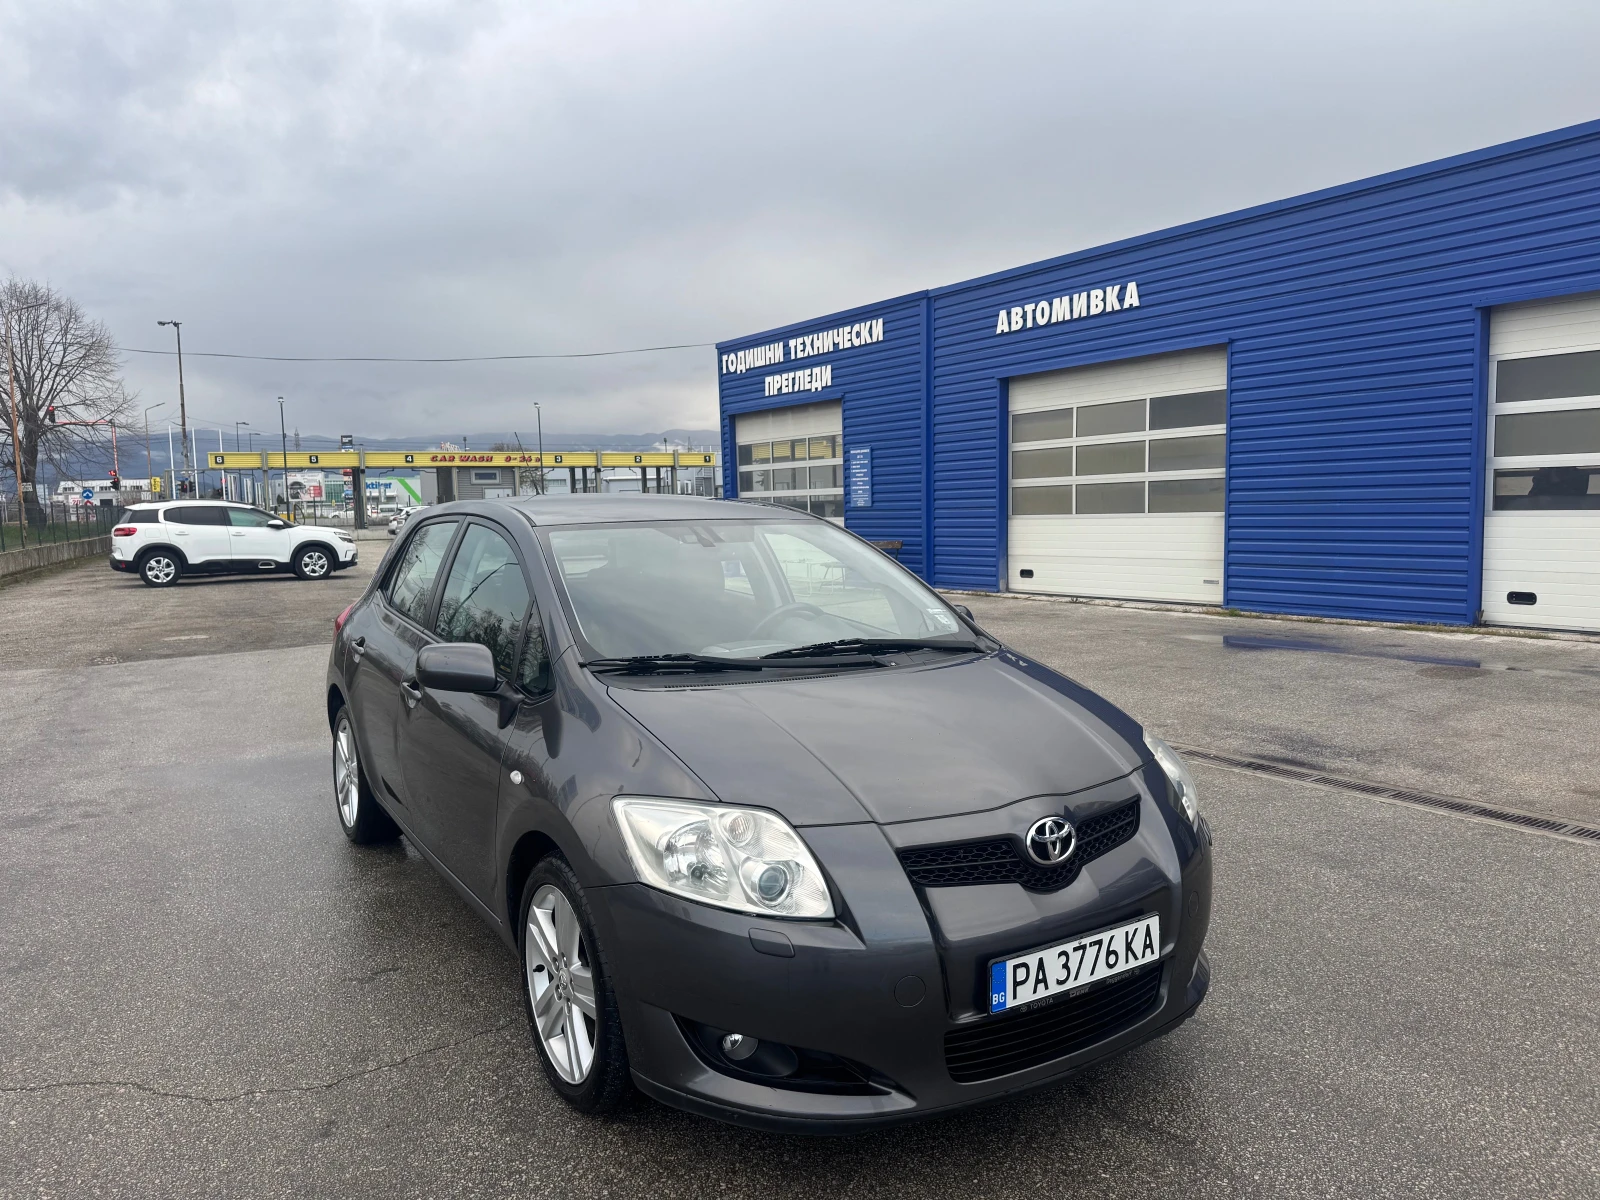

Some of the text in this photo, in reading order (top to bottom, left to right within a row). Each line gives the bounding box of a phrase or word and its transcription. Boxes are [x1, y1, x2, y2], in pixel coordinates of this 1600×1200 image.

[996, 281, 1140, 334] АВТОМИВКА
[722, 318, 883, 374] ГОДИШНИ ТЕХНИЧЕСКИ
[764, 365, 832, 396] ПРЕГЛЕДИ
[365, 481, 392, 489] ktiker
[1012, 923, 1155, 1000] PA 3776 KA
[992, 992, 1005, 1005] BG
[1030, 999, 1054, 1010] TOYOTA
